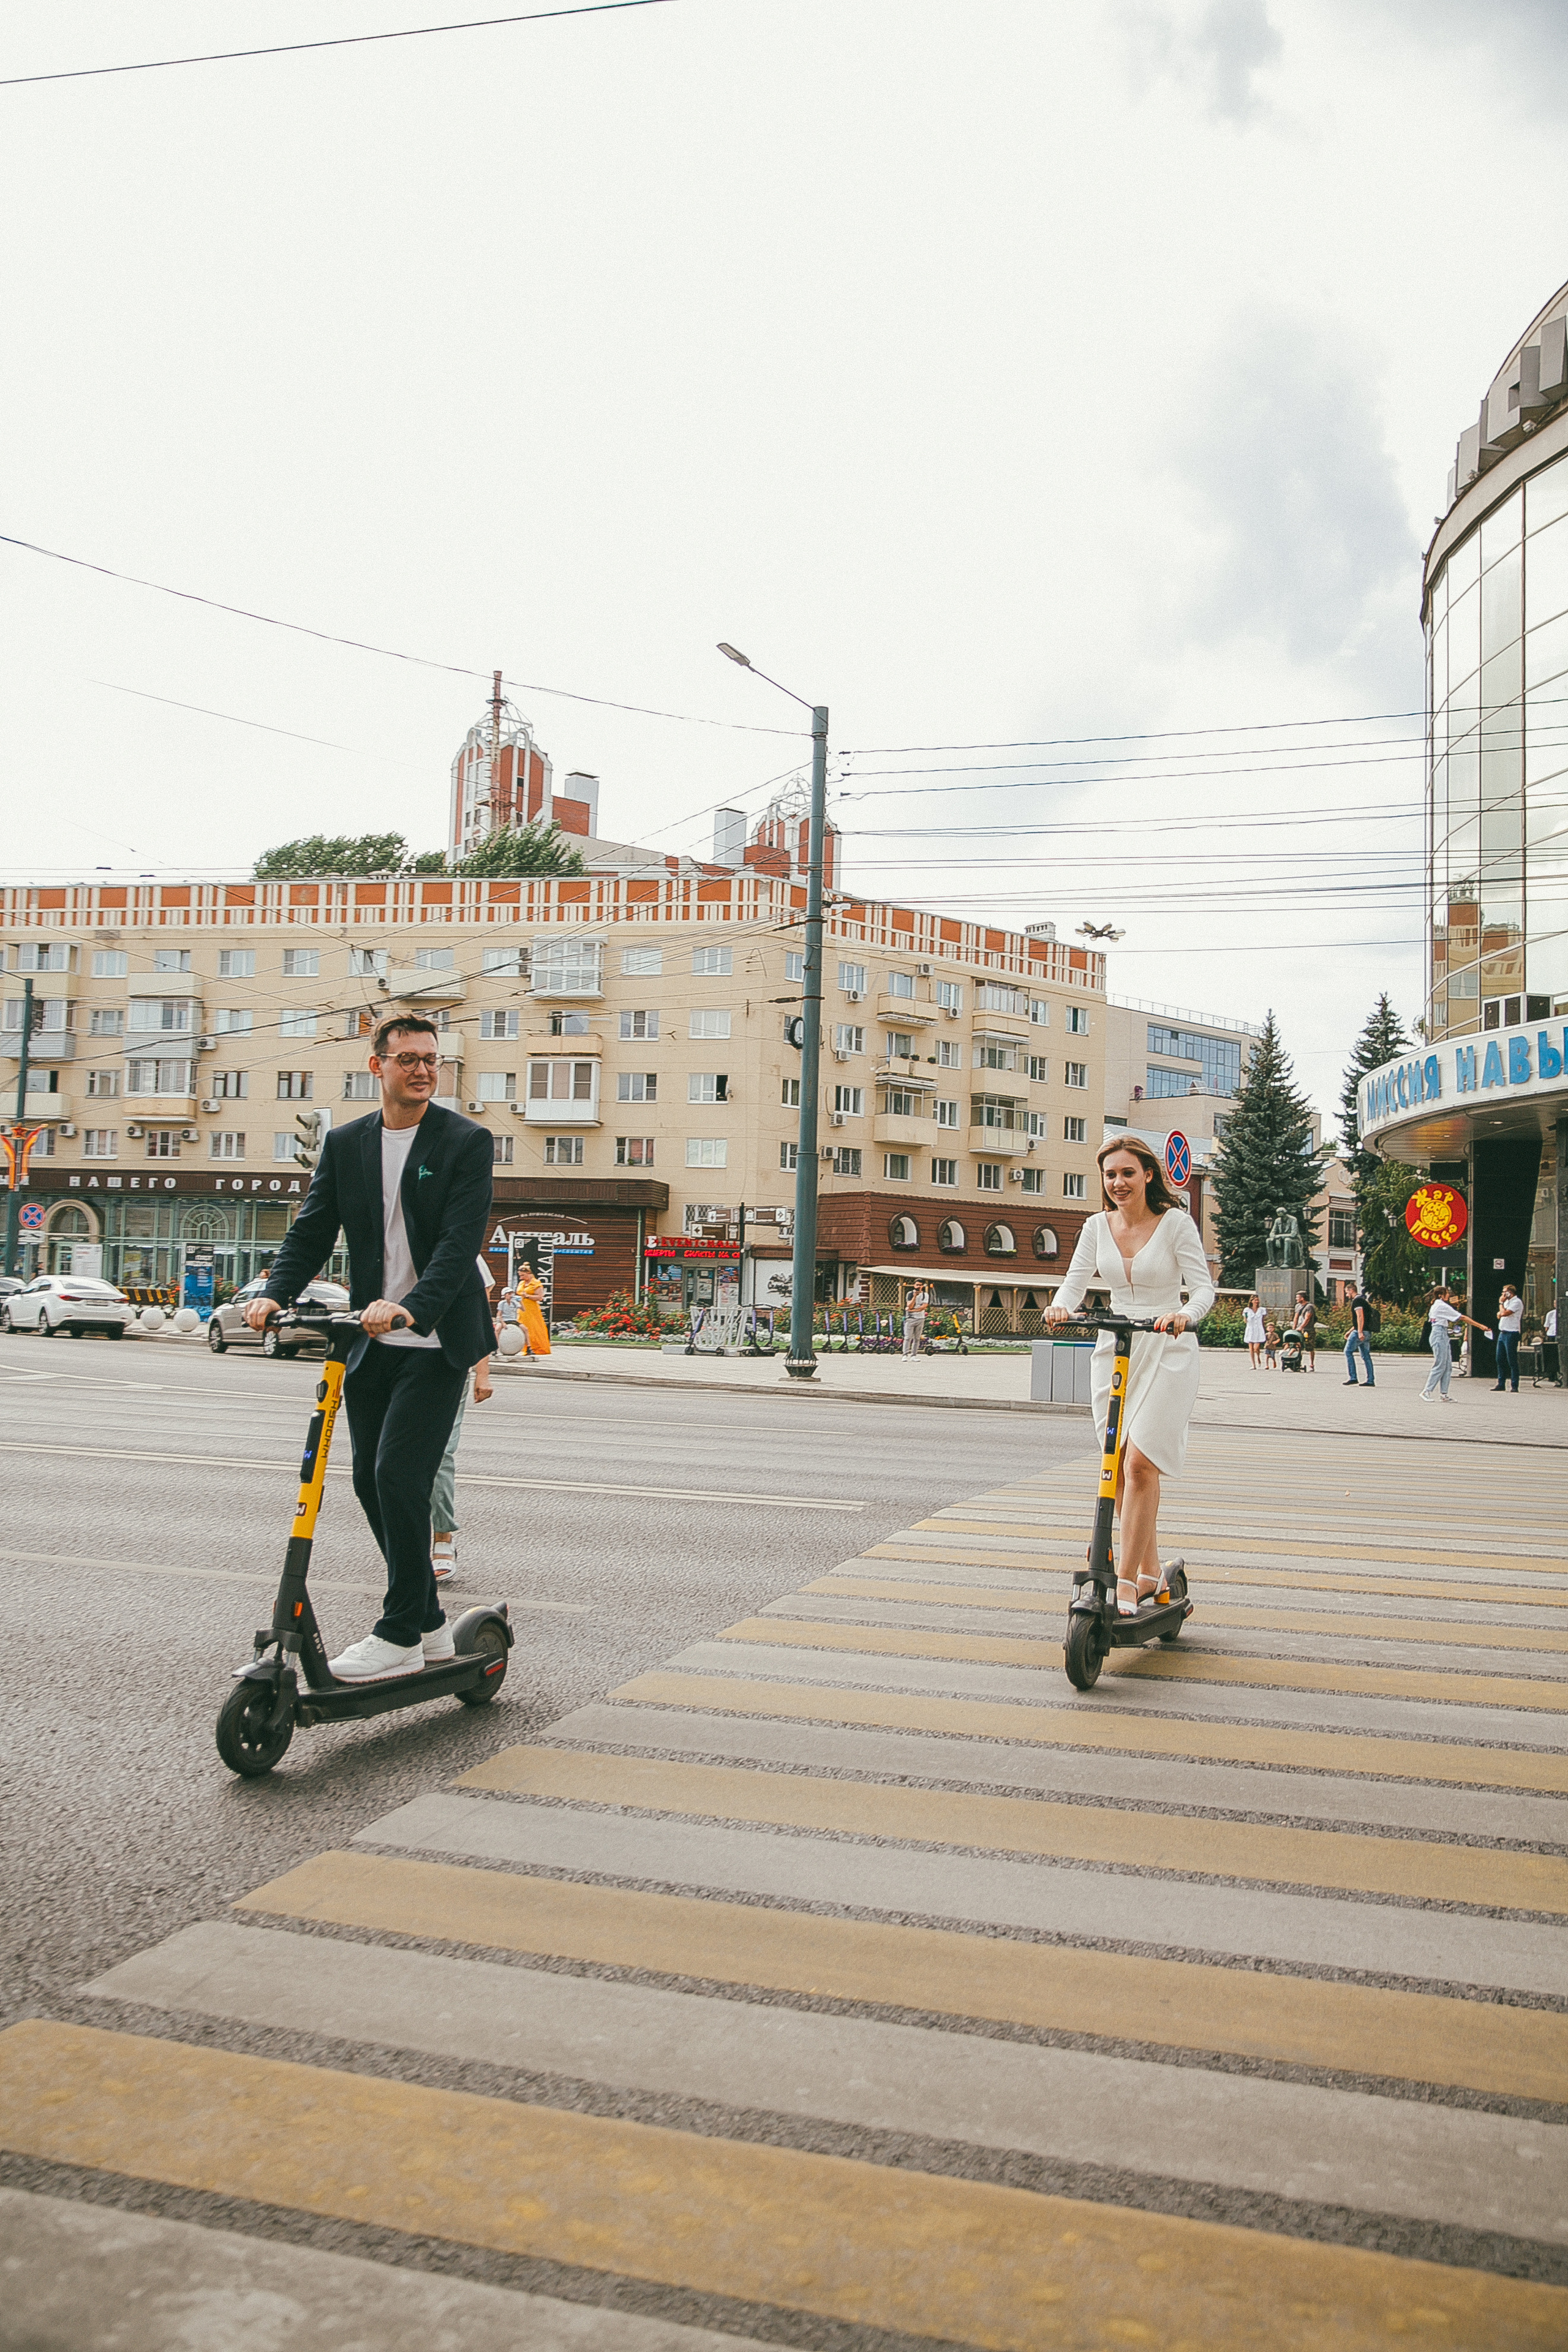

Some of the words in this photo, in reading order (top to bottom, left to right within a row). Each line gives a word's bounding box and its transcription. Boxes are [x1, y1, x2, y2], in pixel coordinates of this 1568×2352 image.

[1366, 1054, 1440, 1121] МИССИЯ
[69, 1176, 176, 1188] НАШЕГО
[215, 1179, 301, 1193] ГОРОД
[1411, 1188, 1454, 1208] Жар
[1409, 1219, 1458, 1245] Пицца
[322, 1400, 337, 1458] WHOOSH
[1102, 1470, 1111, 1479] W
